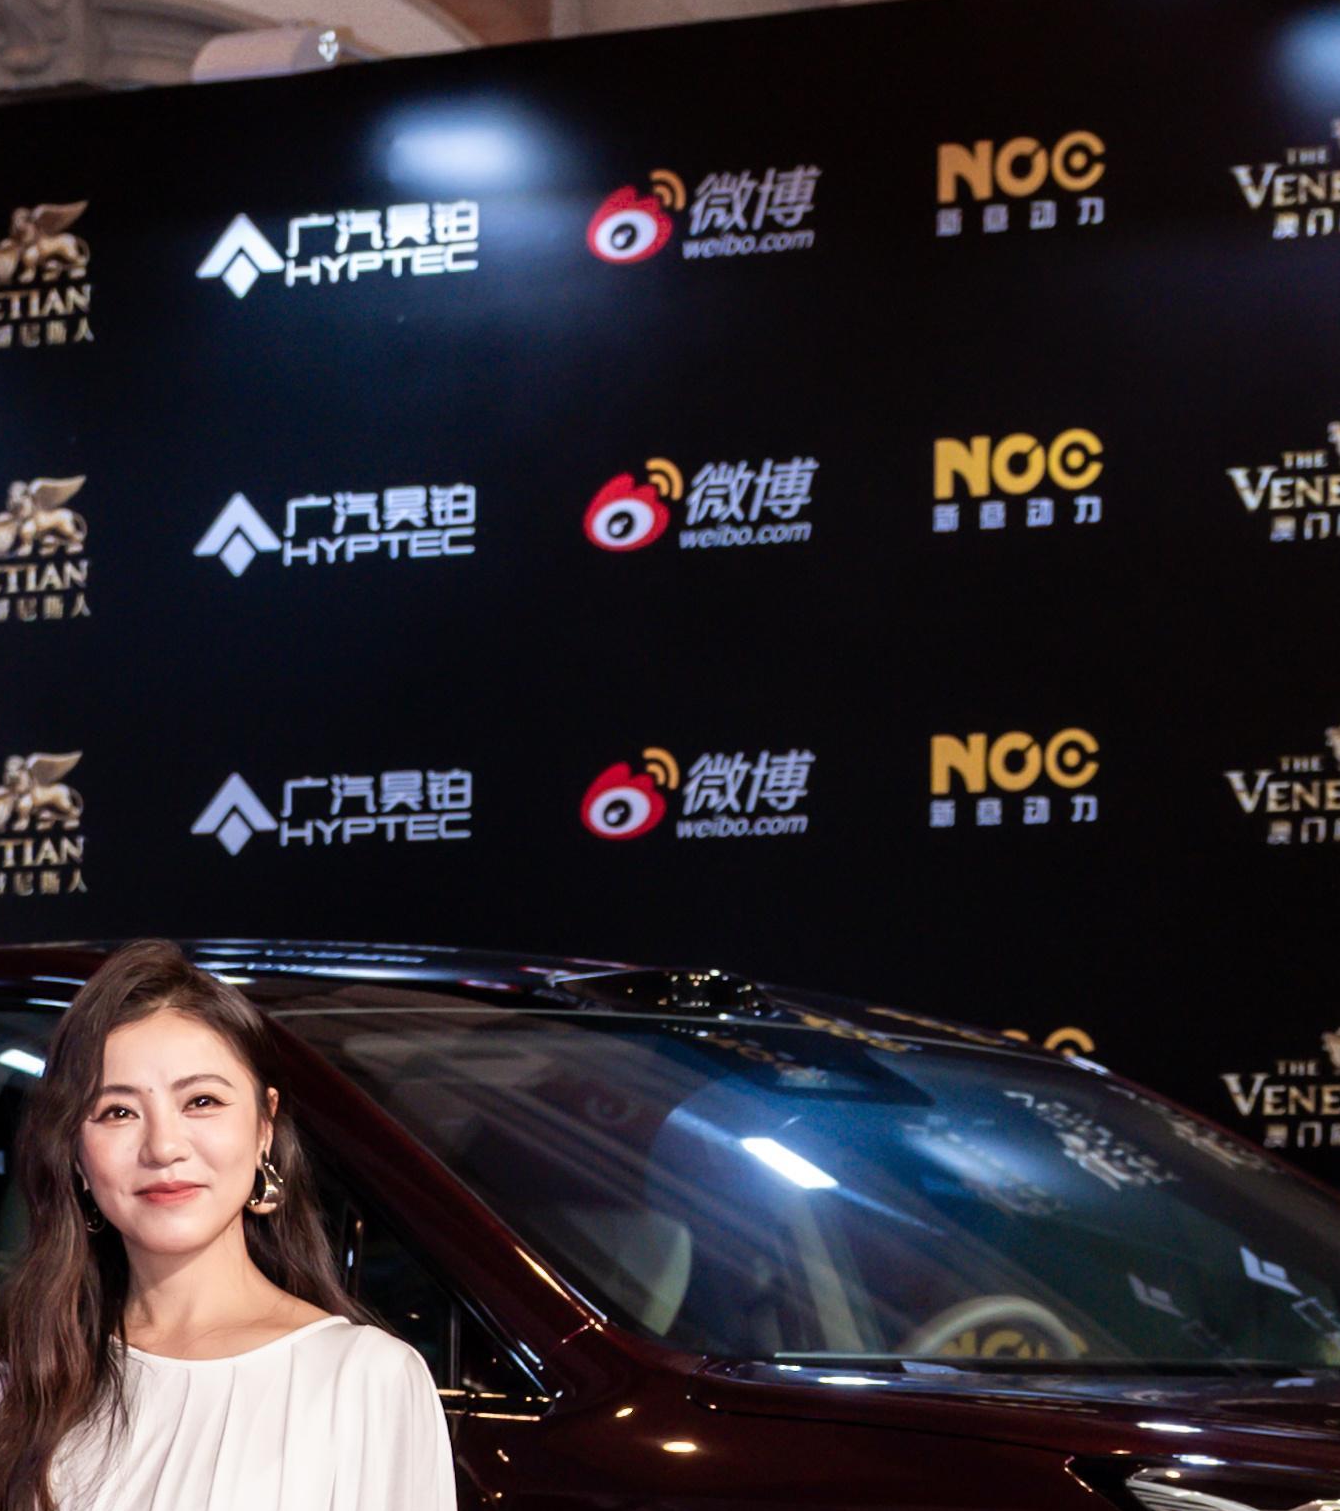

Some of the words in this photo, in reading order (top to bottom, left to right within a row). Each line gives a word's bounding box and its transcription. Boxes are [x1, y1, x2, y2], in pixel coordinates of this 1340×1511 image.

[936, 130, 1106, 203] NOC
[1285, 147, 1328, 165] THE
[689, 164, 822, 236] 微博
[285, 198, 479, 257] 广汽昊铂
[682, 230, 815, 259] weibo.com
[285, 241, 479, 287] HYPTEC
[933, 428, 1102, 499] NOC
[1282, 451, 1325, 469] THE
[282, 483, 476, 538] 广汽昊铂
[686, 456, 819, 526] 微博
[282, 526, 476, 567] HYPTEC
[678, 522, 812, 548] weibo.com
[682, 748, 816, 816] 微博
[930, 727, 1099, 795] NOC
[1280, 755, 1322, 772] THE
[280, 768, 472, 818] 广汽昊铂
[279, 812, 472, 847] HYPTEC
[675, 815, 809, 838] weibo.com
[1277, 1059, 1319, 1076] THE
